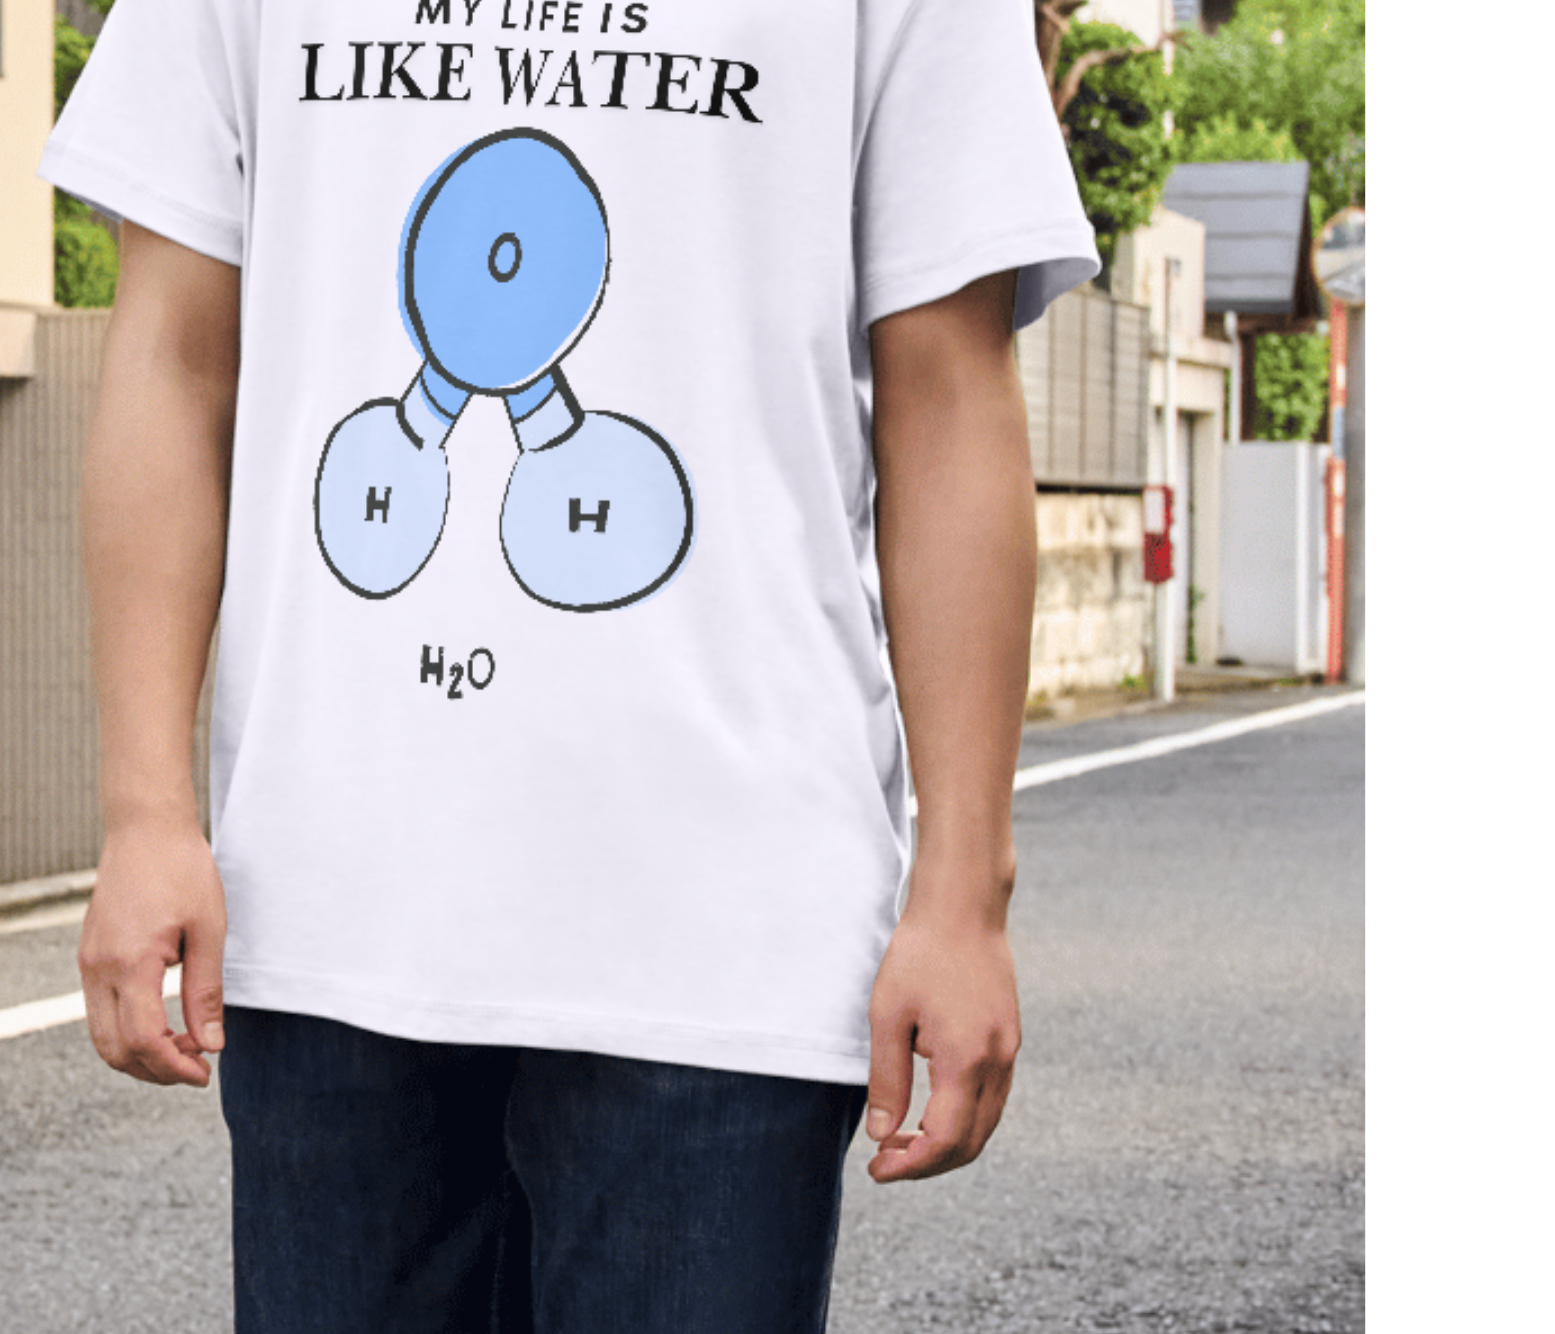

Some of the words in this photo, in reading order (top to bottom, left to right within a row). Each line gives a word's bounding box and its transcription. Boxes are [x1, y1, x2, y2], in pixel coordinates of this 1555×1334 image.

[600, 3, 649, 33] IS
[299, 42, 472, 101] LIKE
[495, 47, 763, 123] WATER
[488, 232, 522, 282] O
[365, 486, 392, 523] H
[568, 498, 611, 532] H
[421, 644, 495, 699] H2O
